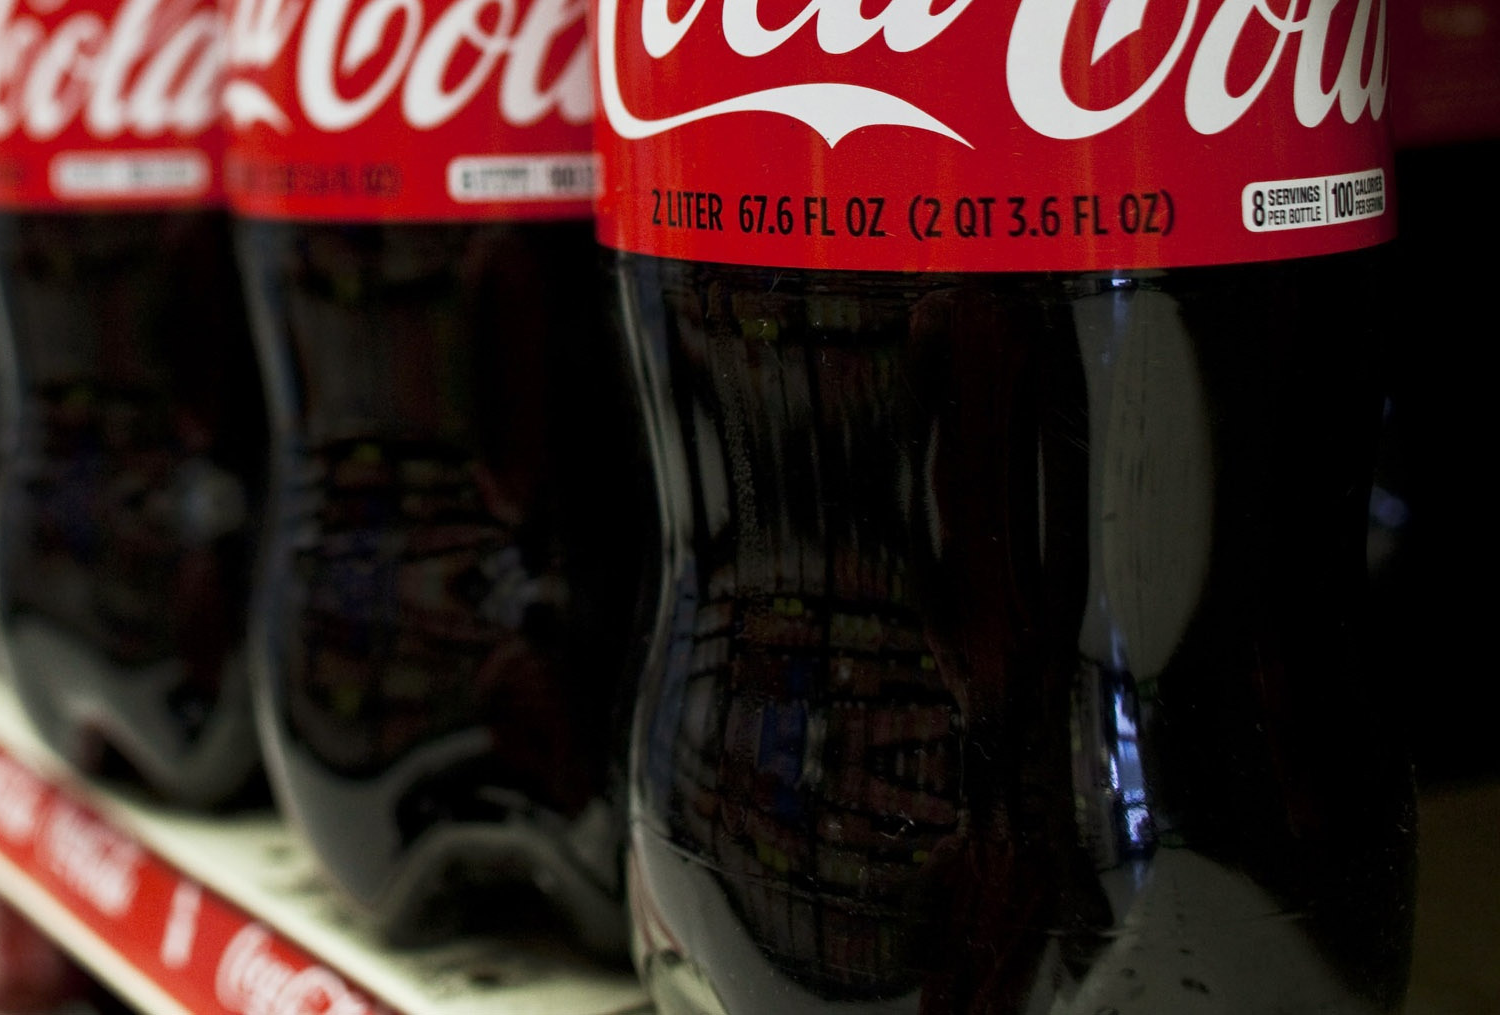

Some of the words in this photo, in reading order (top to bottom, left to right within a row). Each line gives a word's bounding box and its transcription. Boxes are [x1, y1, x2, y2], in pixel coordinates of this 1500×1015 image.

[1252, 190, 1265, 226] 8
[1268, 185, 1320, 206] SERVINGS
[1331, 181, 1354, 218] 100
[652, 189, 661, 226] 2
[667, 190, 723, 231] LITER
[739, 195, 794, 235] 67.6
[804, 197, 835, 236] FL
[846, 197, 886, 238] OZ
[908, 195, 942, 241] (2
[954, 197, 995, 238] QT
[1007, 197, 1061, 237] 3.6
[1073, 195, 1108, 235] FL
[1120, 190, 1175, 236] OZ)
[1268, 208, 1286, 225] PER
[1289, 206, 1321, 224] BOTTLE
